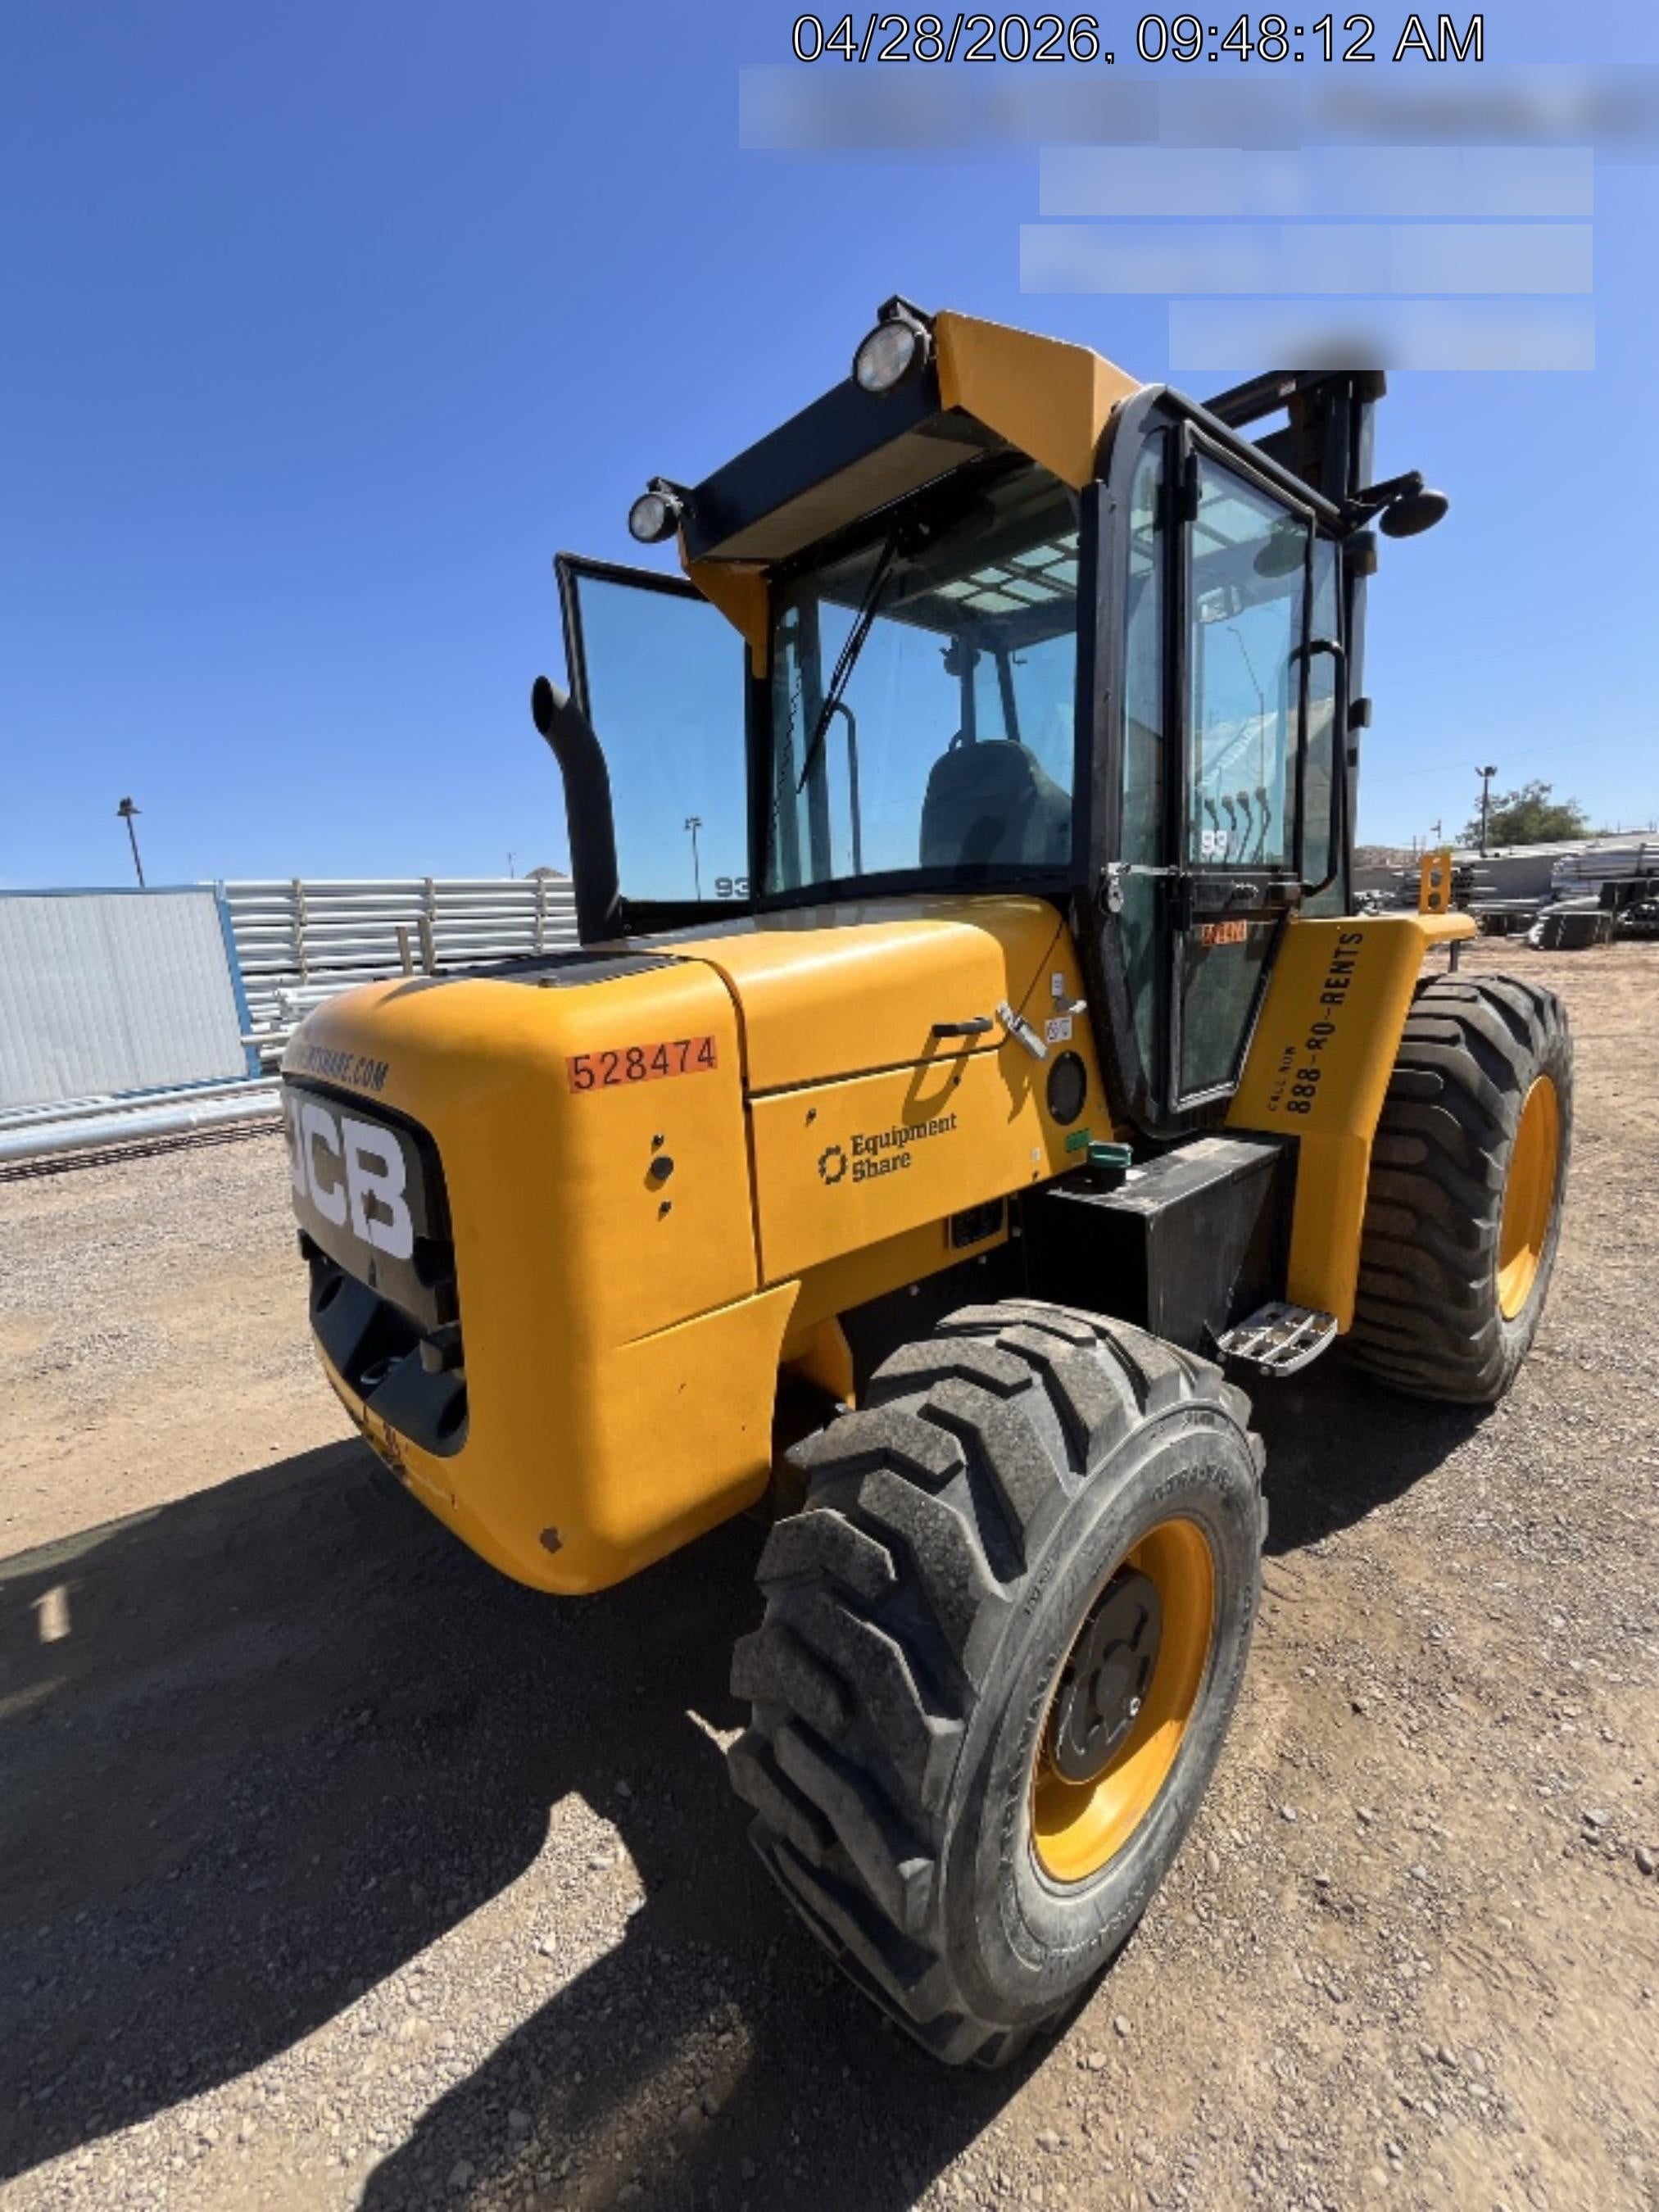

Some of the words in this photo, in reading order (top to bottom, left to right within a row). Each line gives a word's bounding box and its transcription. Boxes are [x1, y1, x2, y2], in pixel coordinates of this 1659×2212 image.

[573, 1036, 715, 1090] 528474
[850, 1113, 957, 1156] Equipment
[290, 1096, 414, 1259] JCB
[851, 1152, 912, 1183] Share
